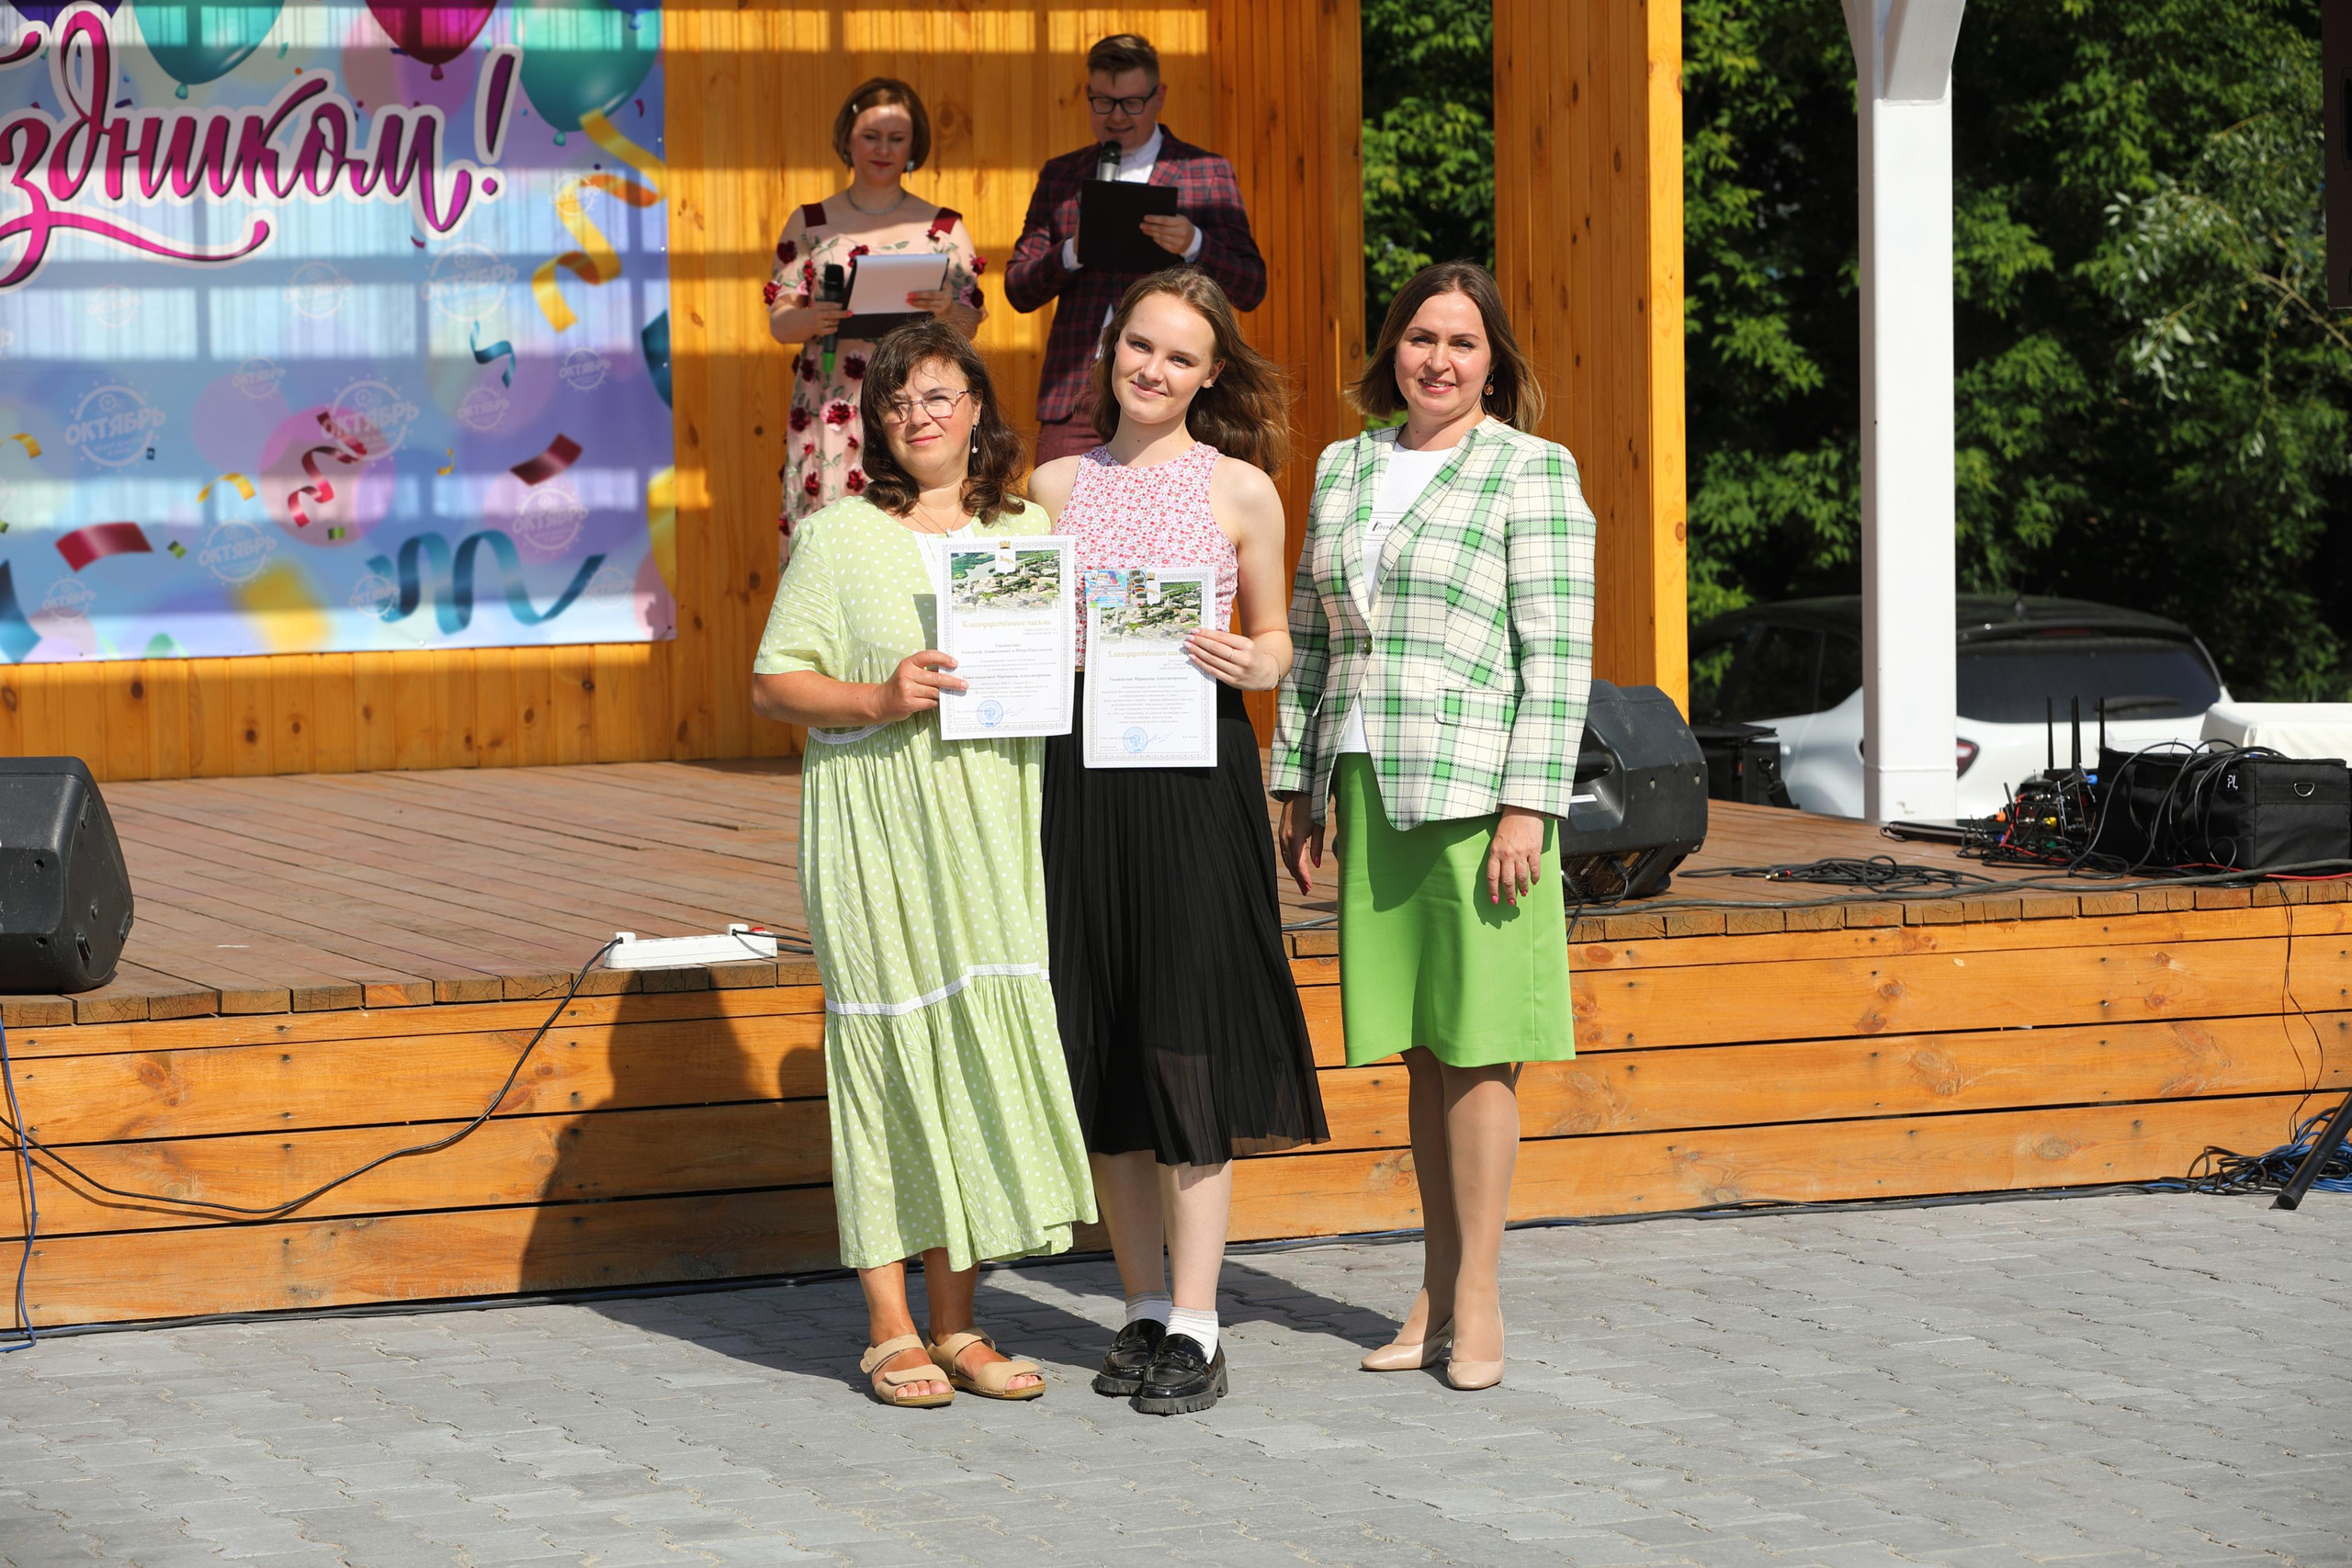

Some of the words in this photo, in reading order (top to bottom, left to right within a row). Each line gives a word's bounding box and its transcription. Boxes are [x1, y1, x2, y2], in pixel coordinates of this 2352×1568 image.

[420, 264, 518, 301] ОКТЯБРЬ
[65, 405, 167, 446] ОКТЯБРЬ
[512, 507, 590, 535] ОКТЯБРЬ
[198, 536, 277, 567] ОКТЯБРЬ
[962, 619, 1026, 629] Благодарственное
[1107, 649, 1167, 659] Благодарственное
